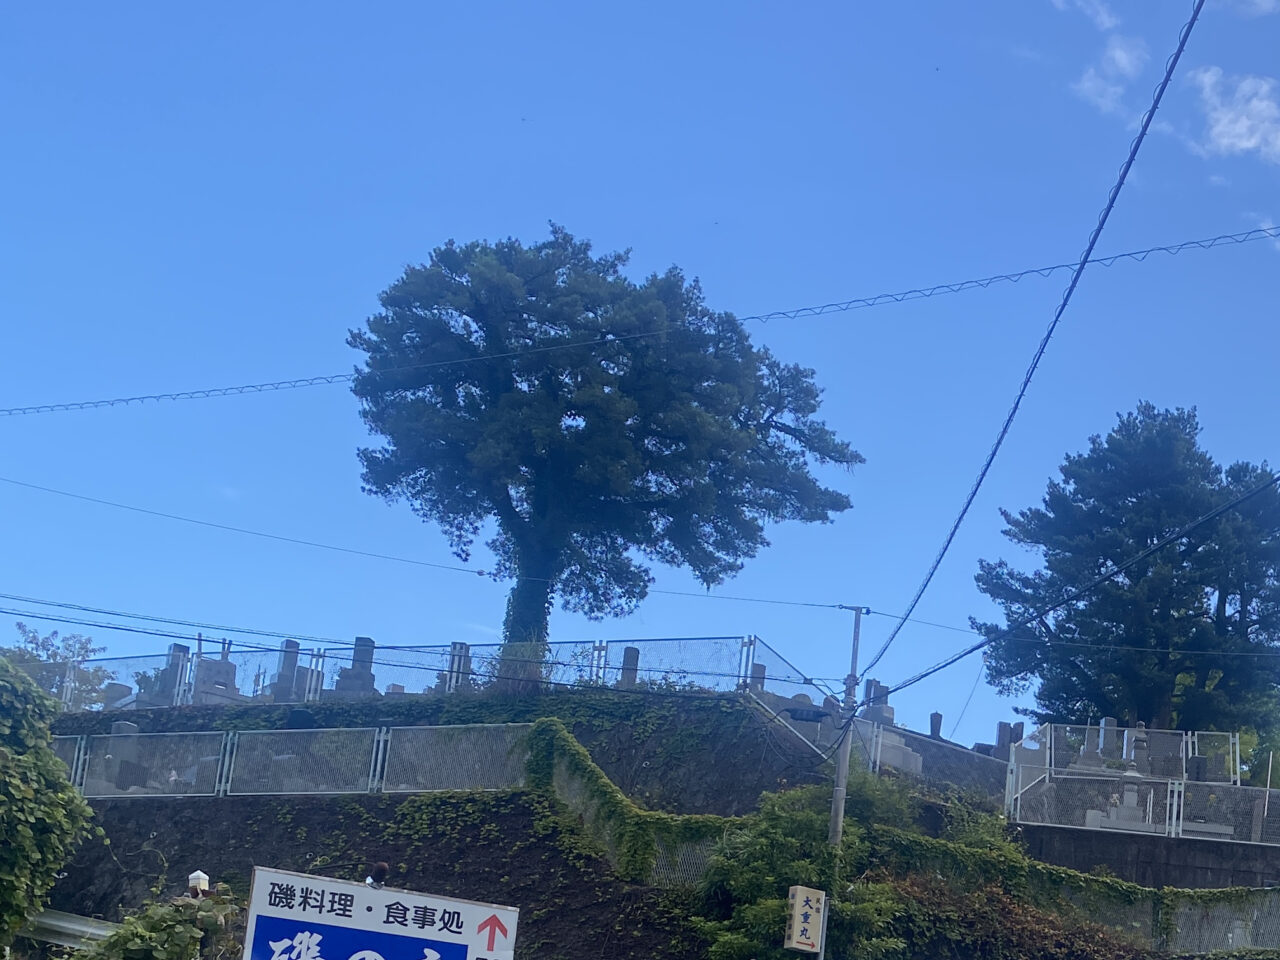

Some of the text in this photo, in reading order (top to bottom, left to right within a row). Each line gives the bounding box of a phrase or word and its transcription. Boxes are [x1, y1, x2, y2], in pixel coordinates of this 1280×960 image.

[268, 882, 463, 935] 磯料理・食事処
[800, 896, 813, 939] 大重丸
